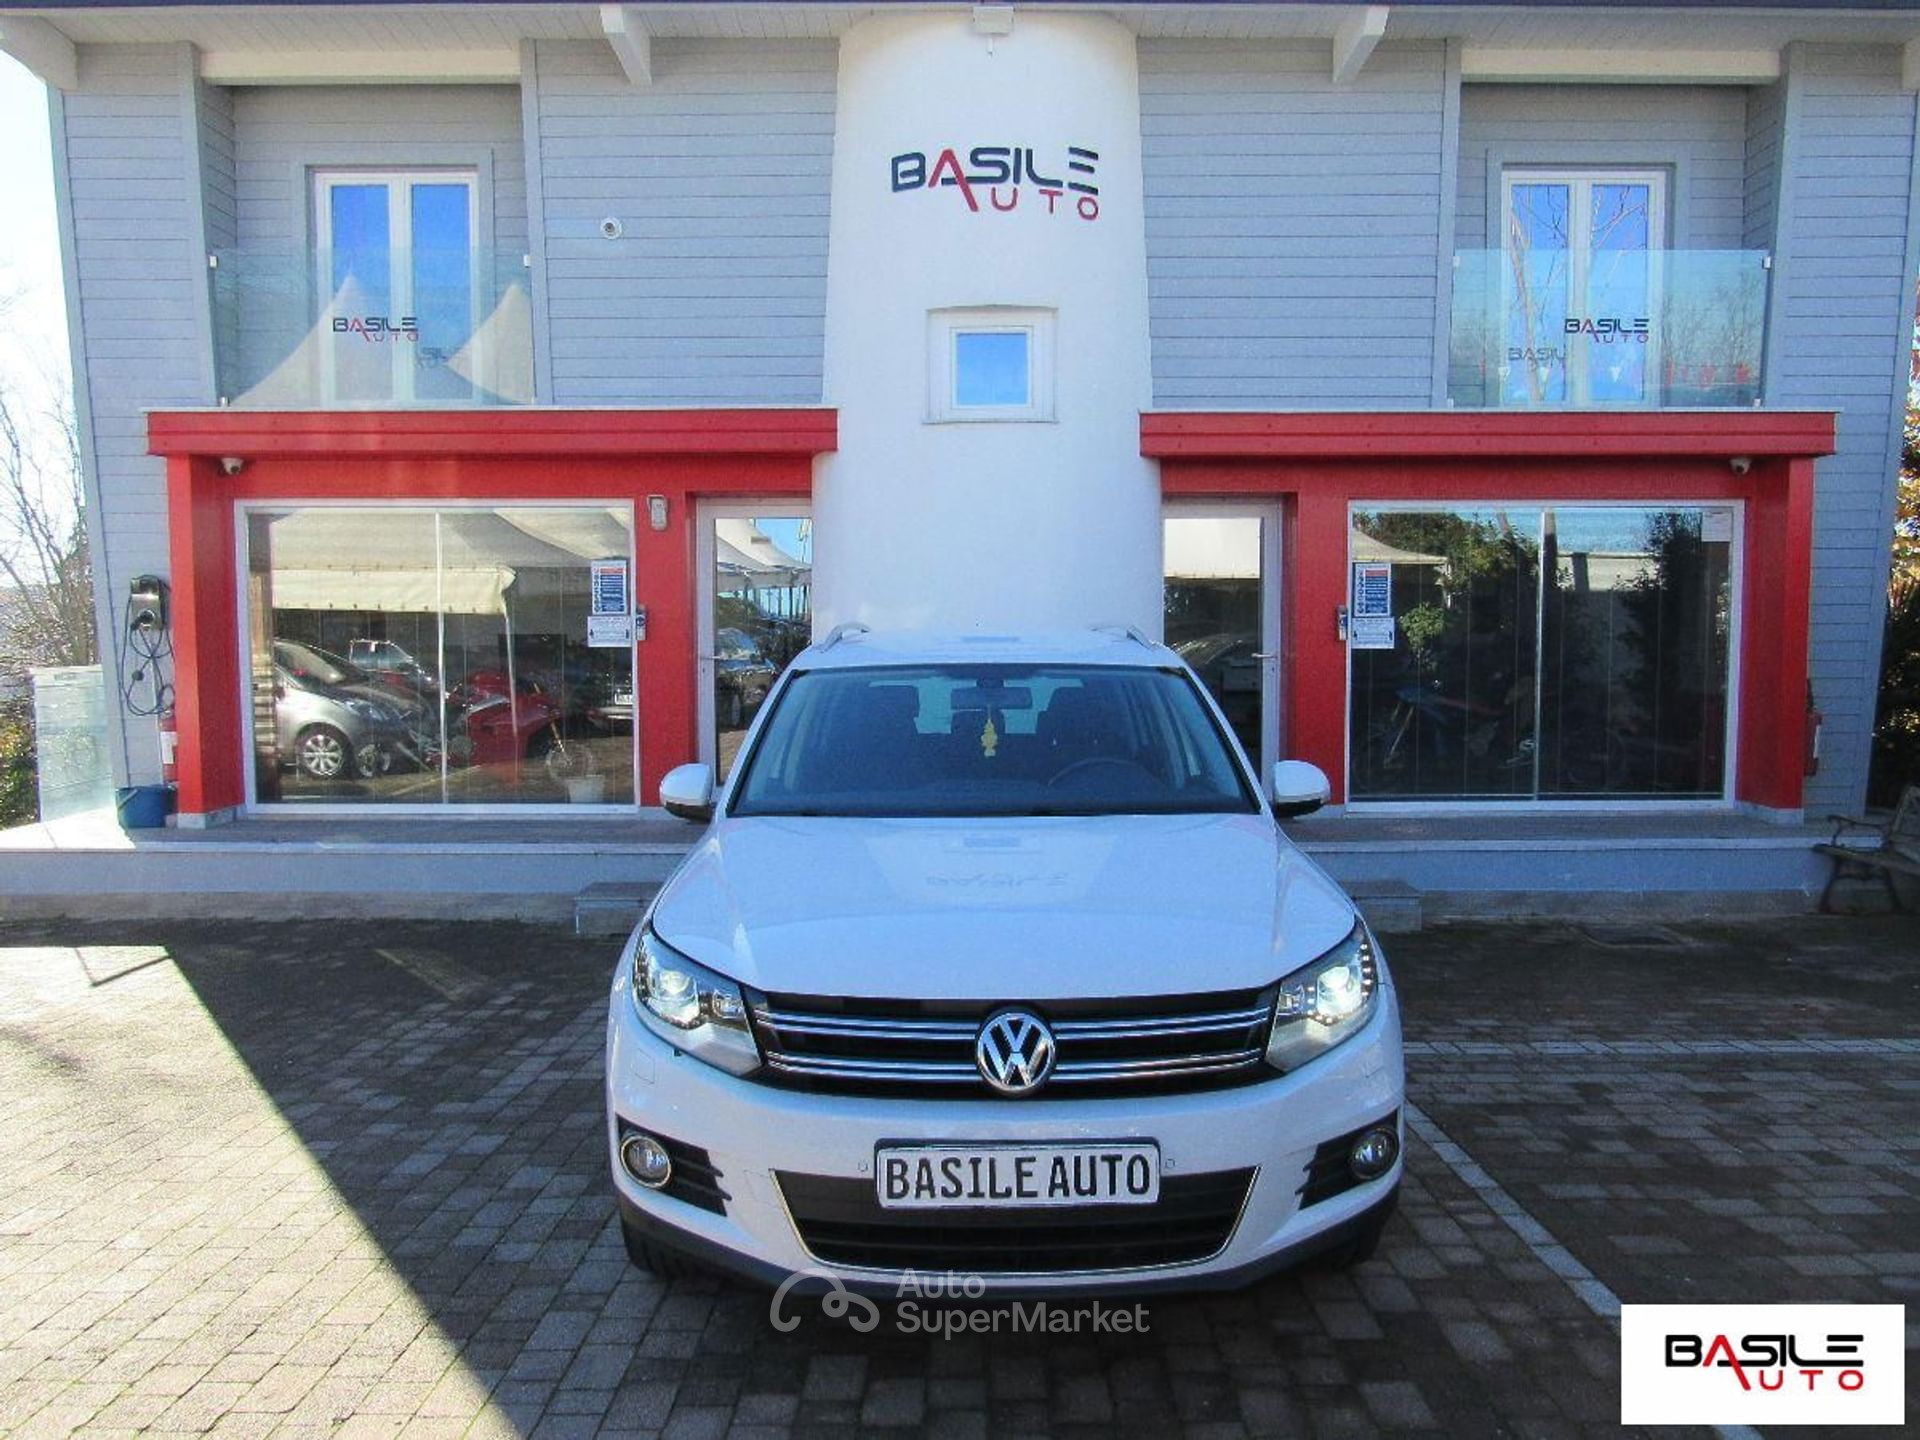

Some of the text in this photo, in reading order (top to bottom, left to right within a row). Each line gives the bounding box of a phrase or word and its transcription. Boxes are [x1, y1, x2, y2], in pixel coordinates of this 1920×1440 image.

[891, 146, 1099, 198] BASILE
[332, 316, 419, 333] BASILE
[1564, 317, 1649, 335] BASILE
[886, 1154, 1150, 1200] BASILE AUTO
